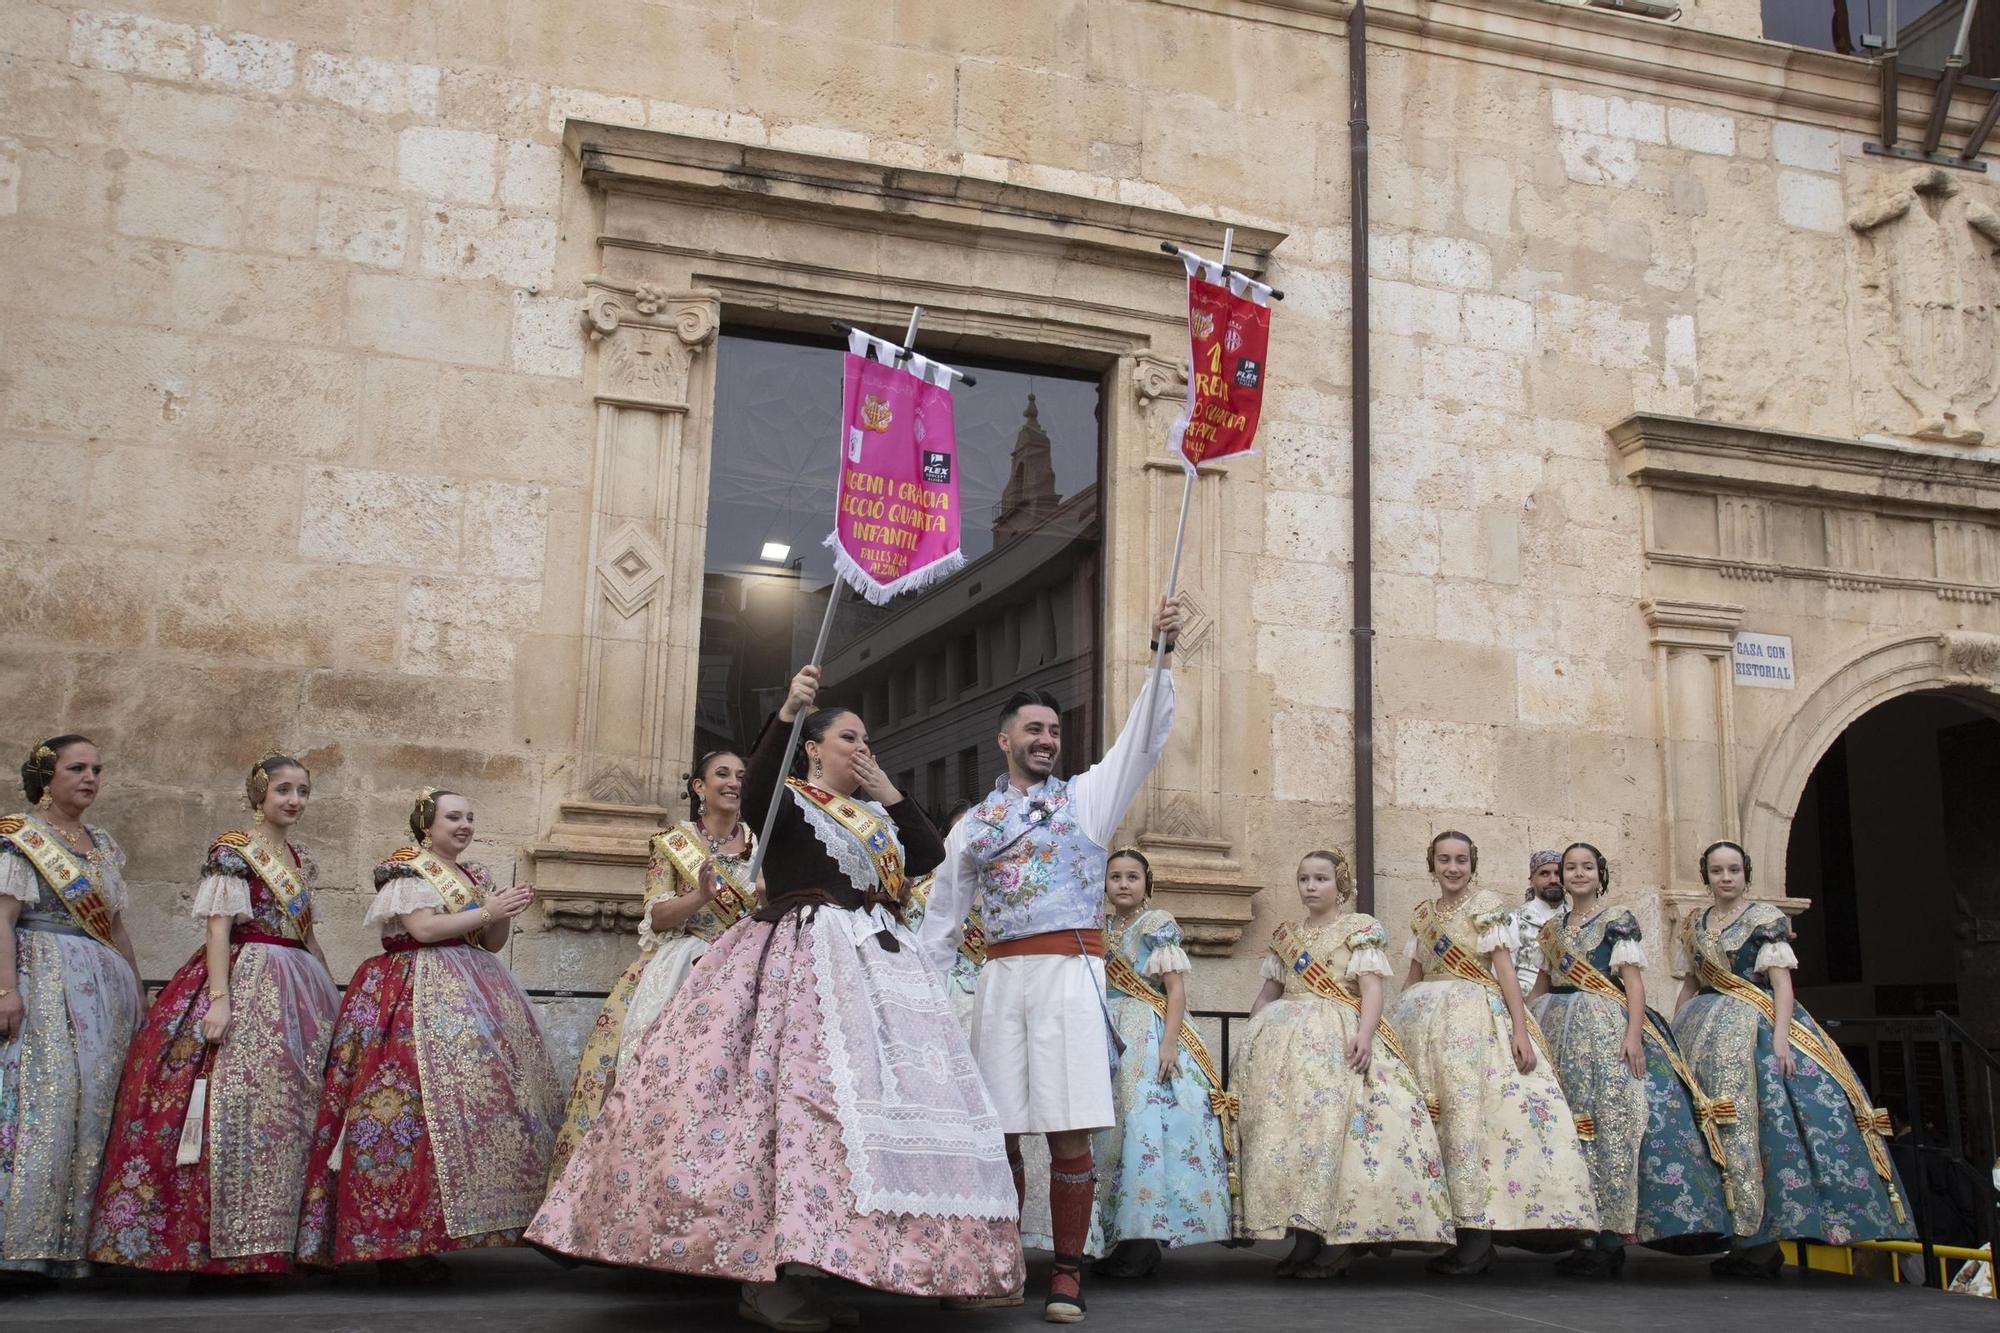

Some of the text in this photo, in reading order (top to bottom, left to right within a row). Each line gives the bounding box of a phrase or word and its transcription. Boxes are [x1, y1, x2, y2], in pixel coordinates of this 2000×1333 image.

[1236, 370, 1258, 381] FLEX
[924, 465, 949, 475] FLEX
[842, 493, 946, 533] ECCIÓ QUARTA
[853, 521, 918, 551] INFANTIL
[860, 547, 890, 564] FALLES
[1736, 642, 1785, 659] CASA CON
[1736, 662, 1791, 680] SISTORIAL
[858, 819, 874, 834] 2024
[273, 869, 288, 885] 2024
[440, 879, 457, 894] 2024
